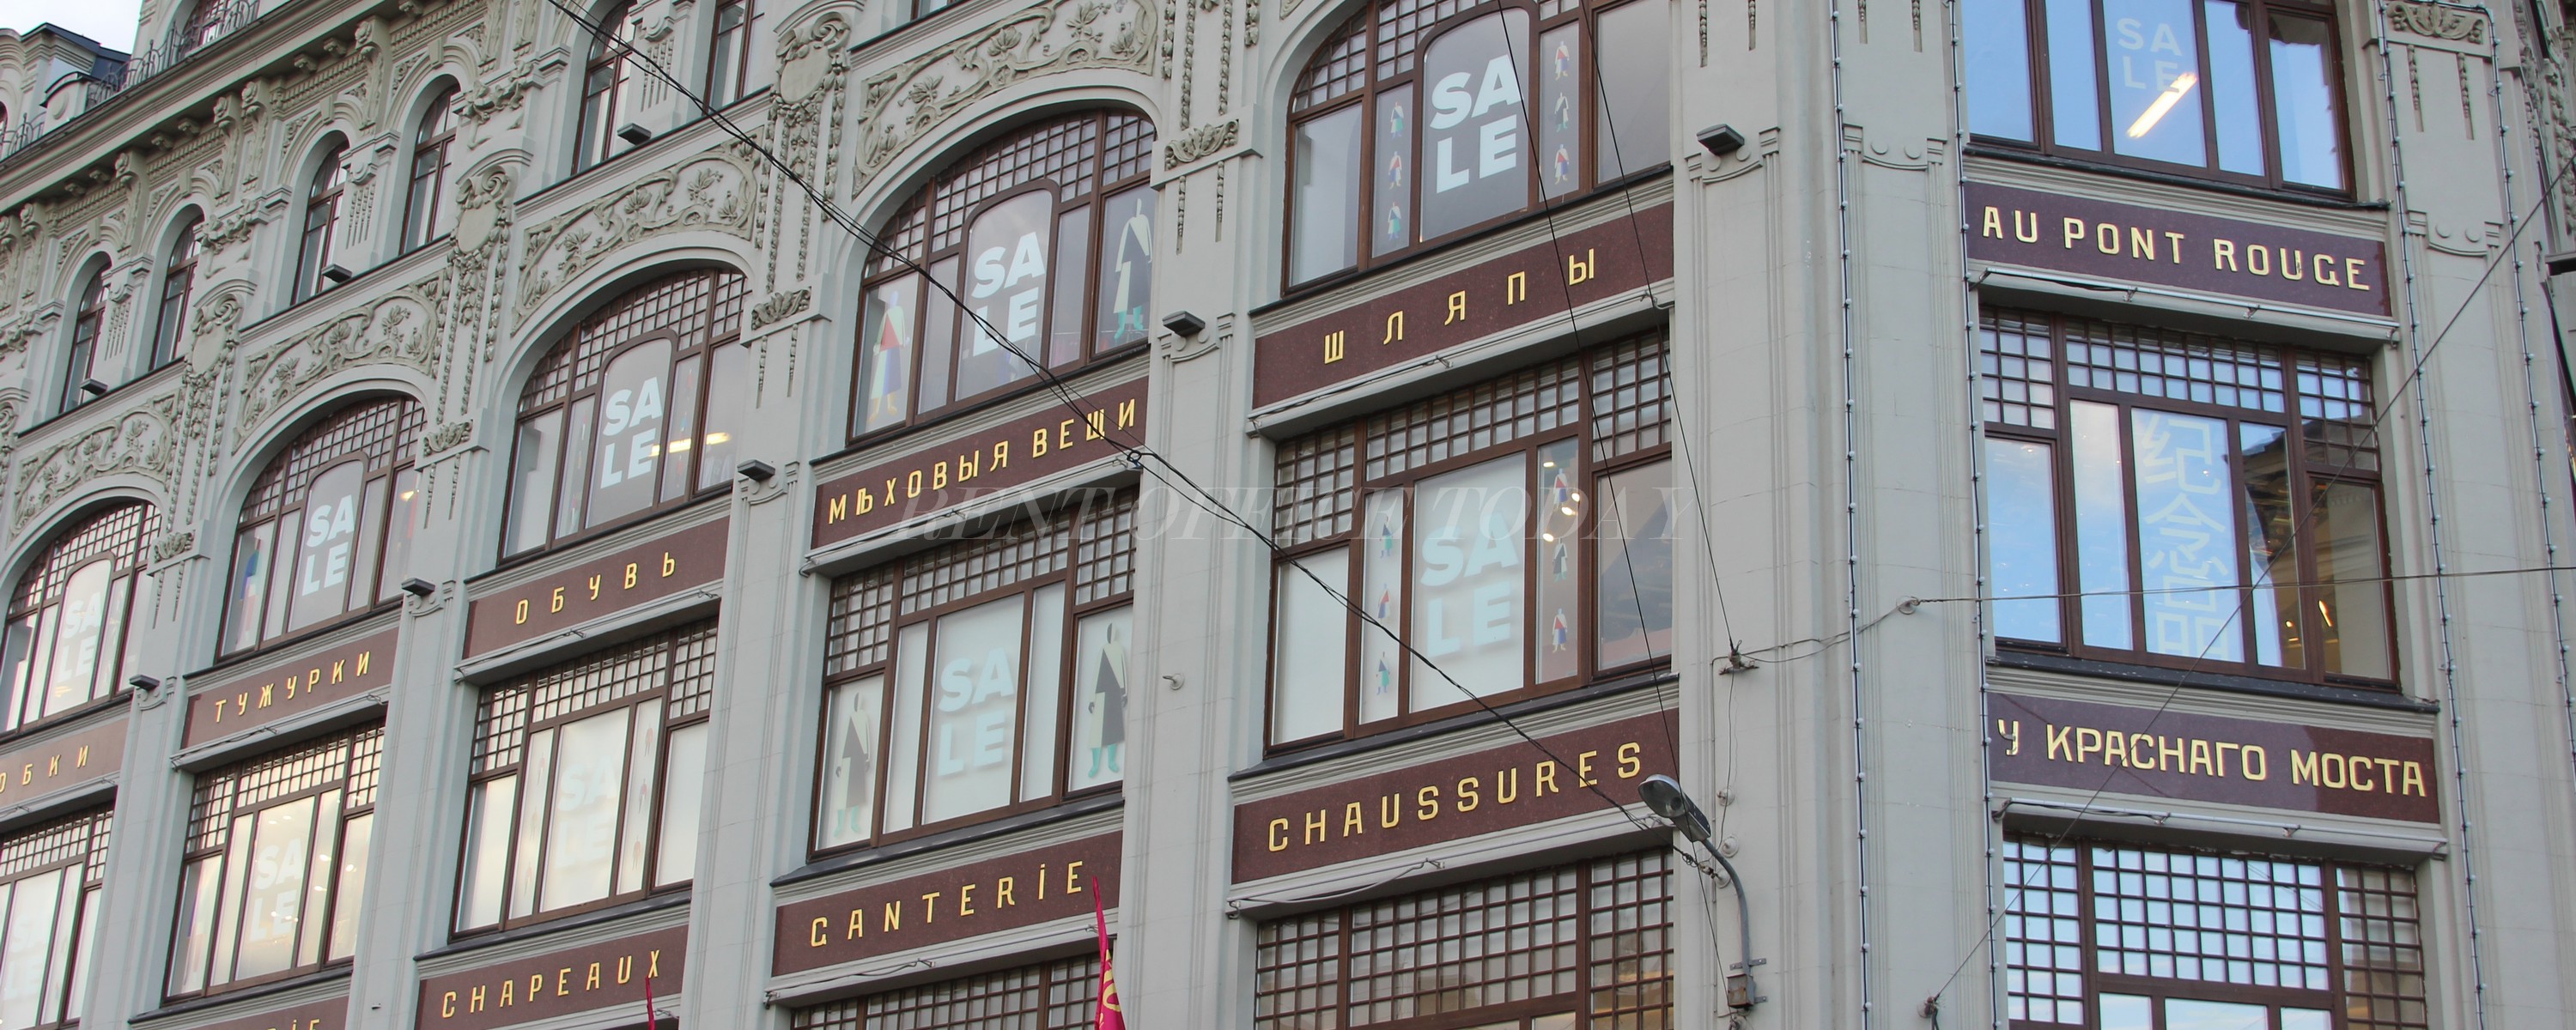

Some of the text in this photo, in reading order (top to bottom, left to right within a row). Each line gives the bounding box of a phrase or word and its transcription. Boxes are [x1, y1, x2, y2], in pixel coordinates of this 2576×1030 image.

[1430, 54, 1522, 130] SA
[1437, 114, 1517, 194] LE
[971, 231, 1046, 299] SA
[1982, 205, 2371, 291] AU PONT ROUGE
[972, 287, 1040, 357] LE
[603, 376, 664, 437] SA
[1031, 397, 1136, 459] ВЕЩИ
[600, 427, 657, 489] LE
[2143, 412, 2230, 659] 纪念品
[515, 551, 676, 625] ОБУВЬ
[215, 650, 371, 723] ТУЖУРКИ
[1996, 718, 2427, 797] У КРАСНАГО МОСТА
[1267, 741, 1642, 853] CHAUSSURES
[441, 948, 660, 1019] CHAPEAUX
